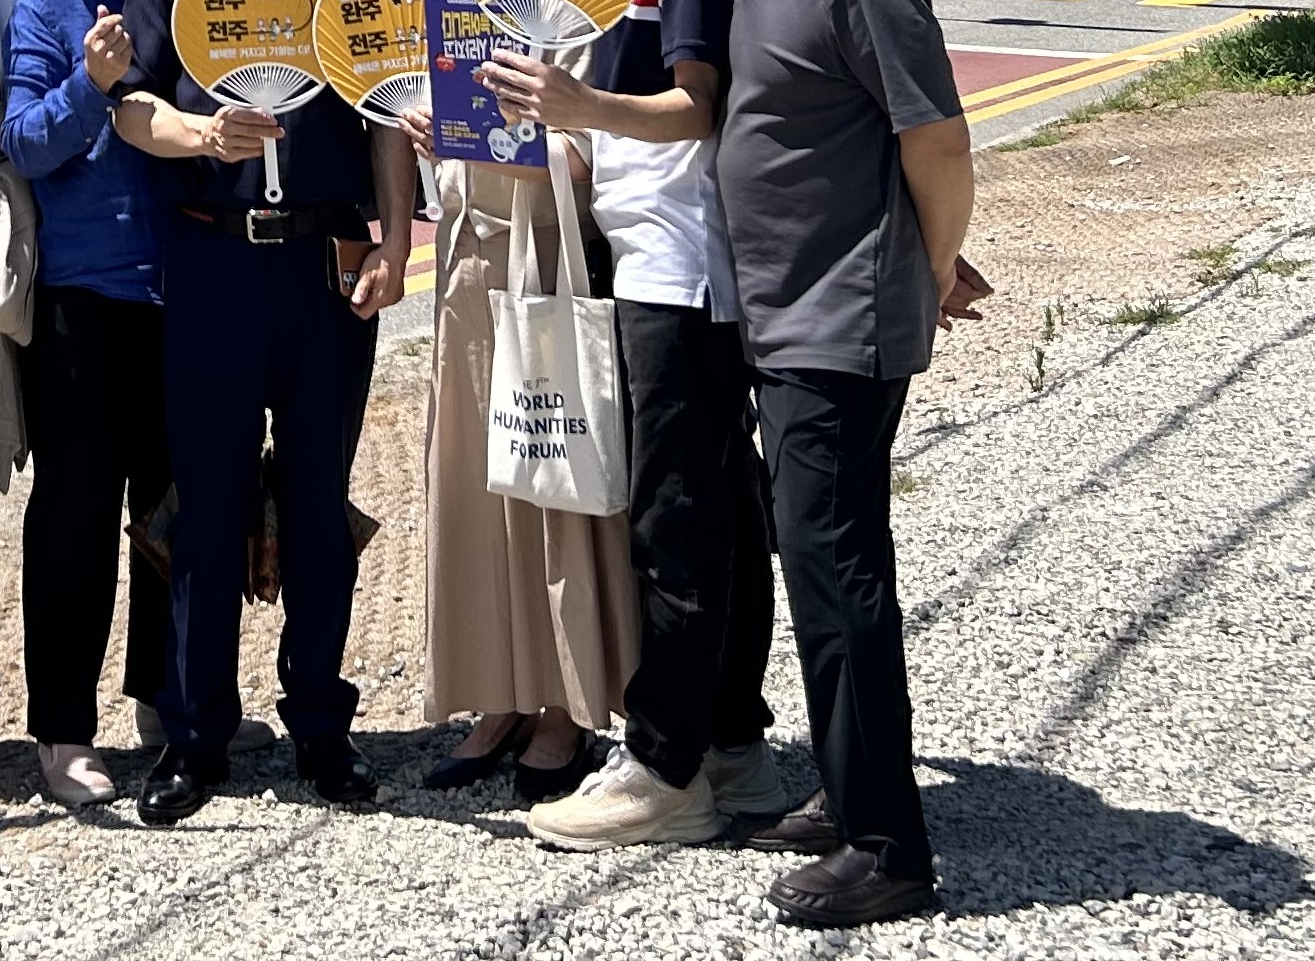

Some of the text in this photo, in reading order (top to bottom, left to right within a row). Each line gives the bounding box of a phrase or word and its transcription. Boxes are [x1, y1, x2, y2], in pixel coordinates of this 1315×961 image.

[207, 20, 249, 43] 전주
[347, 30, 389, 57] 전주
[513, 390, 564, 411] WORLD
[493, 409, 587, 435] HUMANITIES
[510, 440, 567, 459] FORUM
